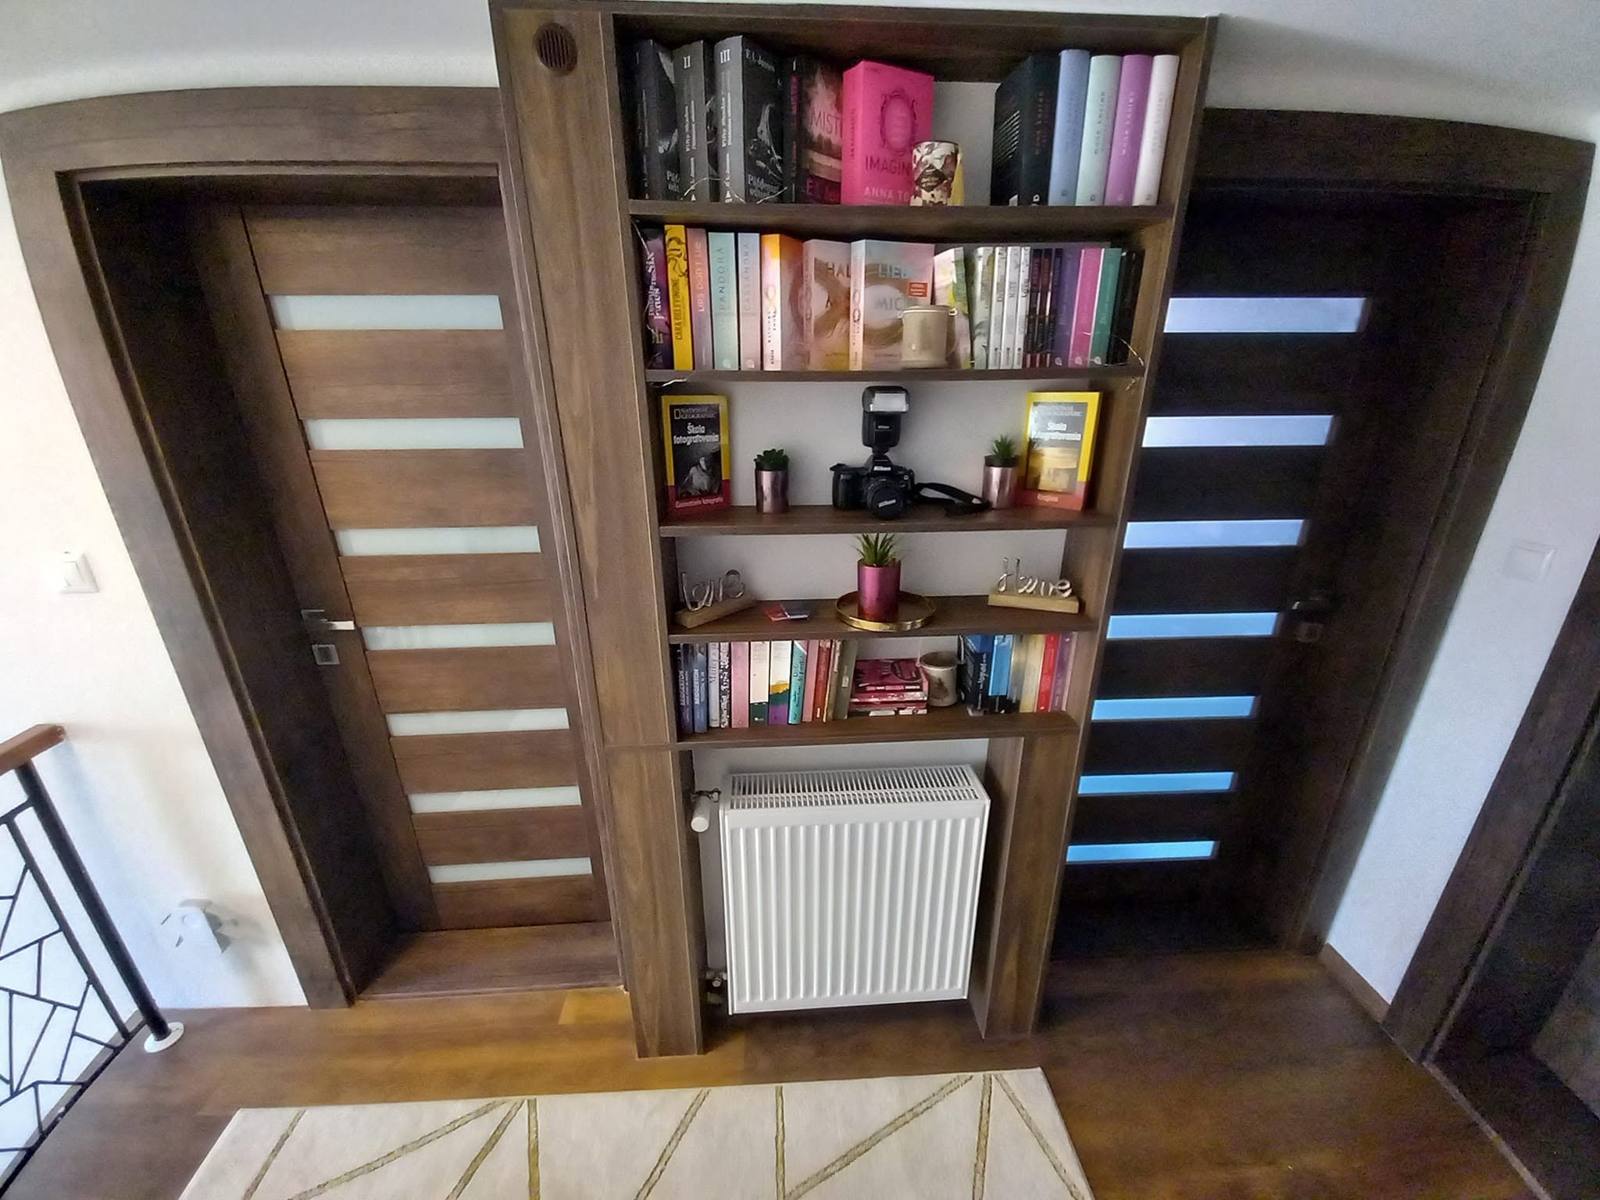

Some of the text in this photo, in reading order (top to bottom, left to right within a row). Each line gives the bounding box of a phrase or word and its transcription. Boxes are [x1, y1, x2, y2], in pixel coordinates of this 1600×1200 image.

[809, 111, 842, 136] MIST
[864, 155, 913, 177] IMAGIN
[897, 189, 912, 202] TO
